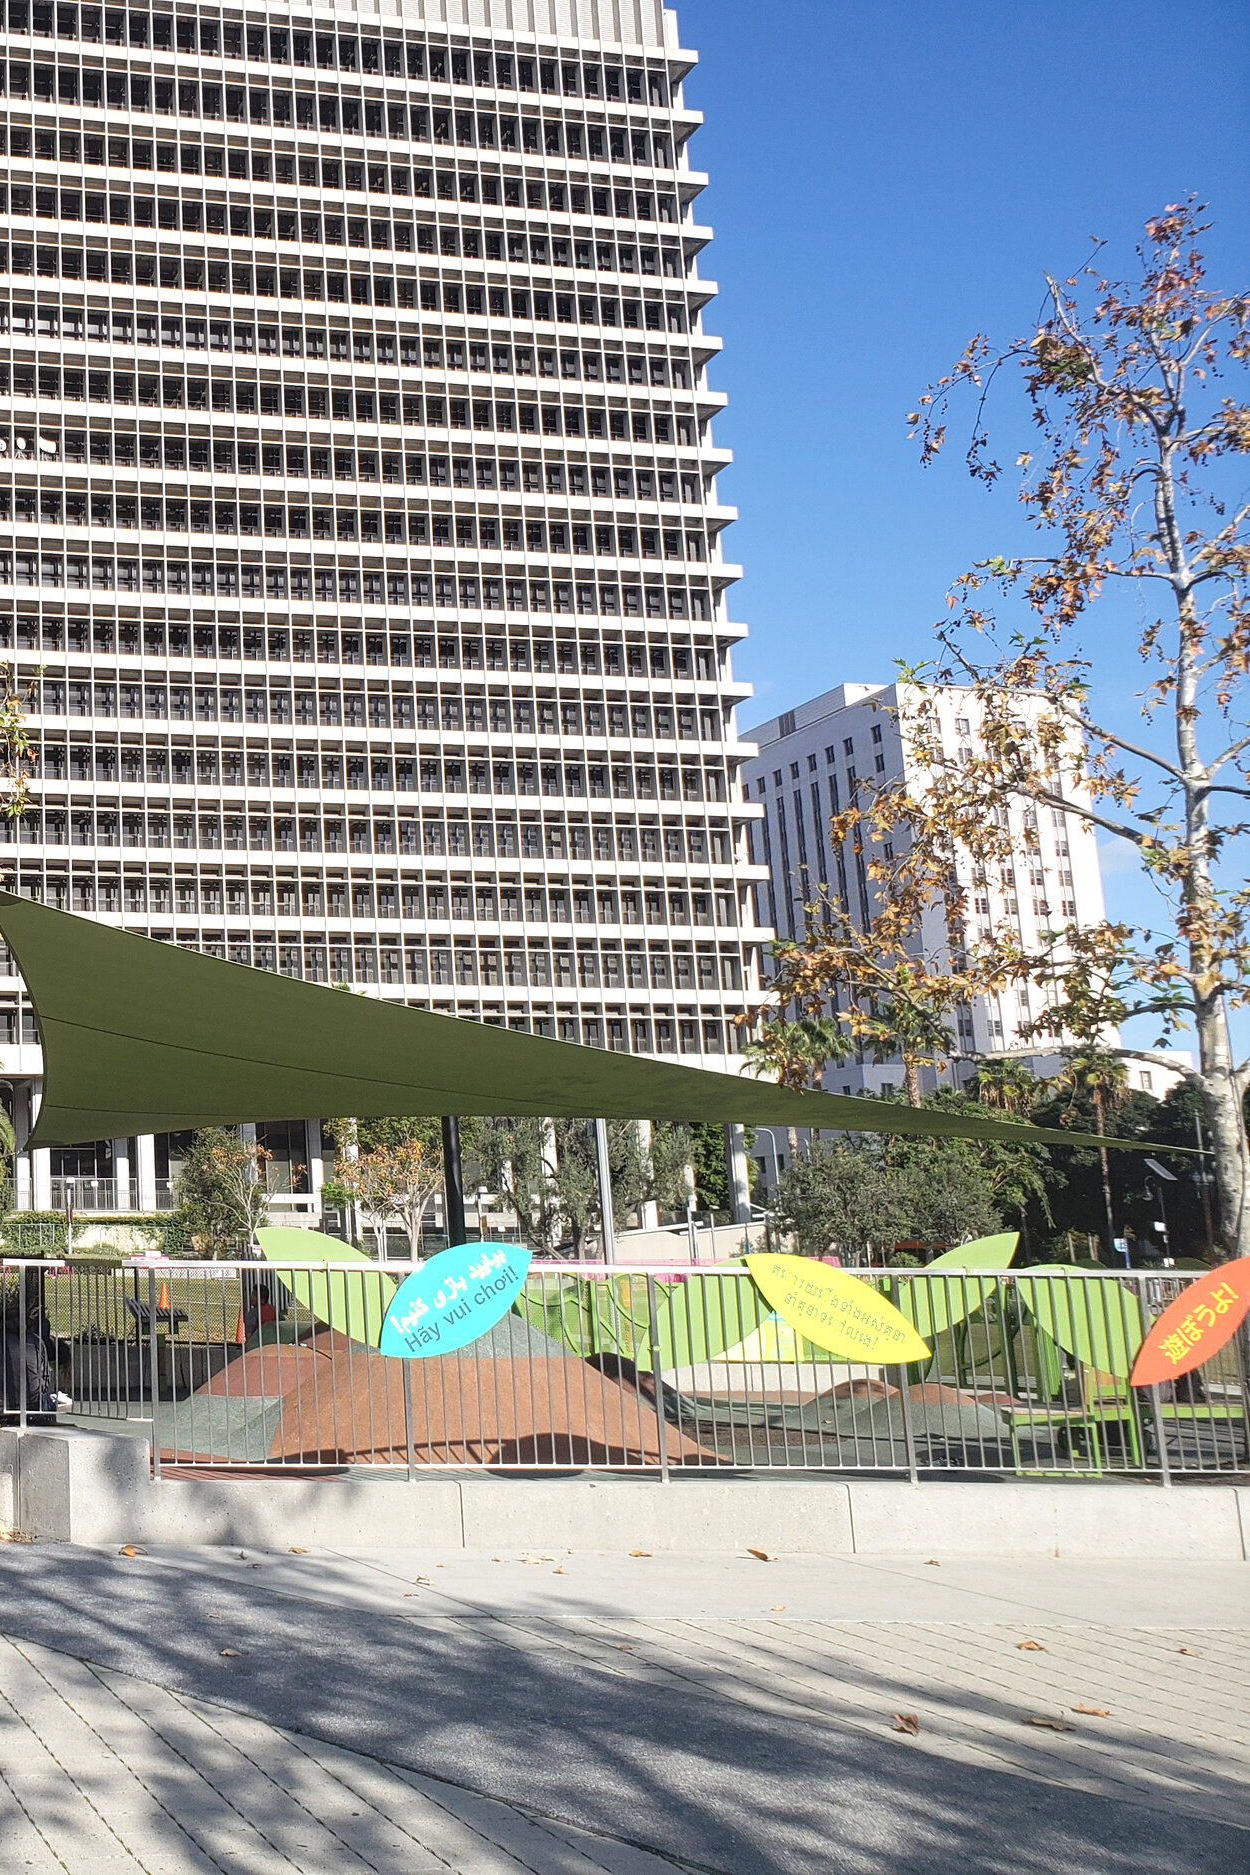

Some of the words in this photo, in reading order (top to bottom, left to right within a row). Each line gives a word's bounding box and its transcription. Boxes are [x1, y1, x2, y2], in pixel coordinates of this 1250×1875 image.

[404, 1322, 441, 1352] Hãy
[442, 1298, 472, 1326] vui
[473, 1265, 519, 1306] chơi!
[1158, 1282, 1239, 1365] 遊ぼうよ!
